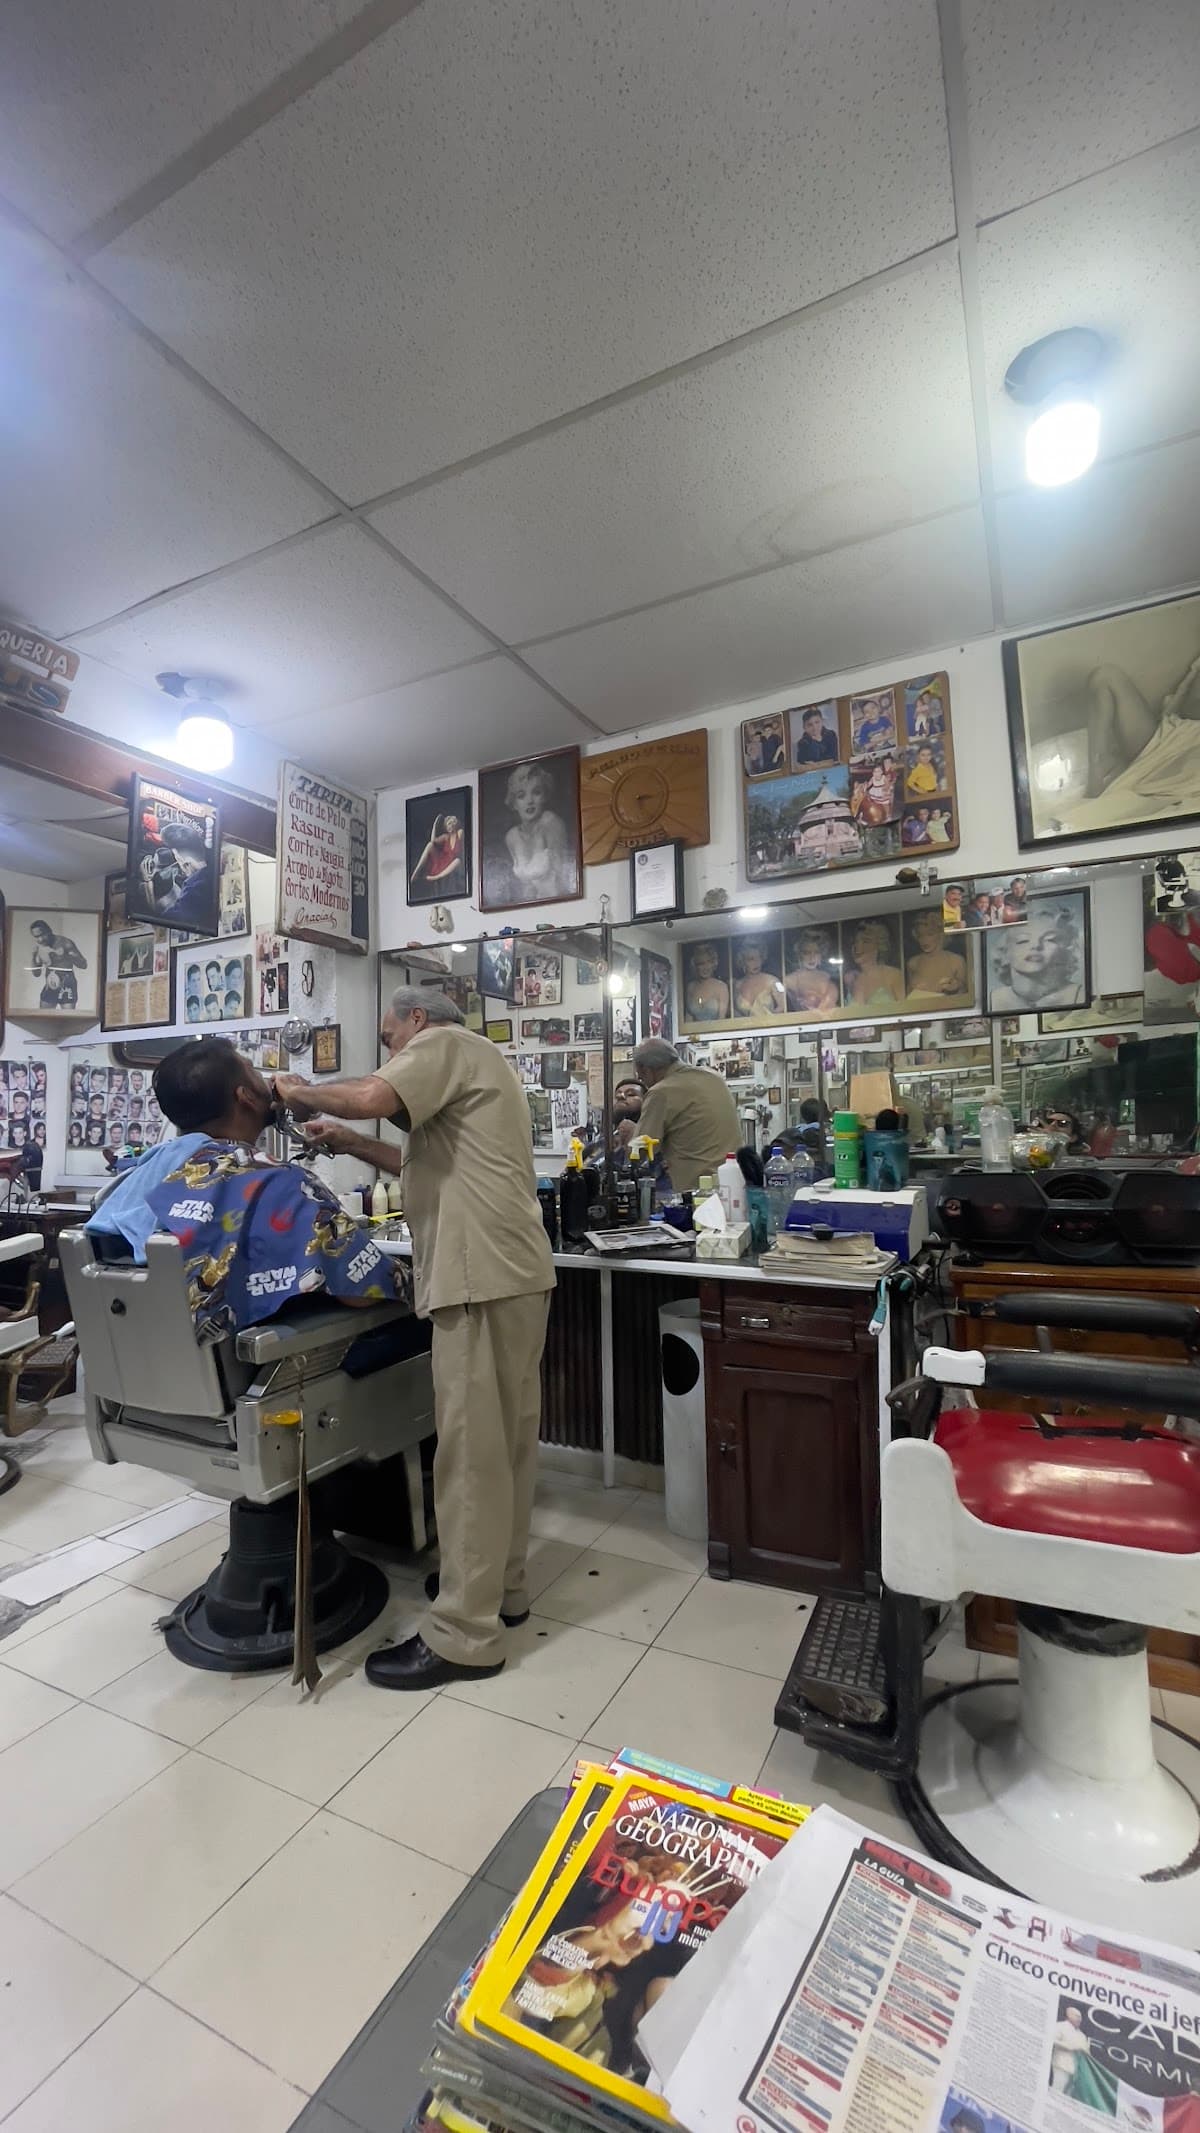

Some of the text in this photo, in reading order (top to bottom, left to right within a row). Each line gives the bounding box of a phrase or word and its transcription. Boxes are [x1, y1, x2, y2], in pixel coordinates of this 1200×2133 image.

[289, 791, 314, 816] Corte
[327, 806, 346, 830] Pelo
[291, 813, 335, 846] Rasura
[288, 836, 314, 858] Corte
[286, 855, 315, 880] Arreglo
[168, 1207, 214, 1223] WARS
[174, 1200, 215, 1213] STAR
[347, 1243, 379, 1272] STAR
[347, 1249, 382, 1284] WARS
[246, 1279, 295, 1297] STAR
[248, 1265, 297, 1286] WARS
[628, 1796, 657, 1813] MAYA
[649, 1807, 760, 1856] NATIONAL
[616, 1814, 763, 1882] GEOGRAPHI
[863, 1858, 906, 1886] LA GUÍA
[631, 1899, 648, 1913] Los
[985, 1940, 1044, 1980] Checo
[1048, 1970, 1145, 2015] convence
[1149, 2001, 1168, 2022] al
